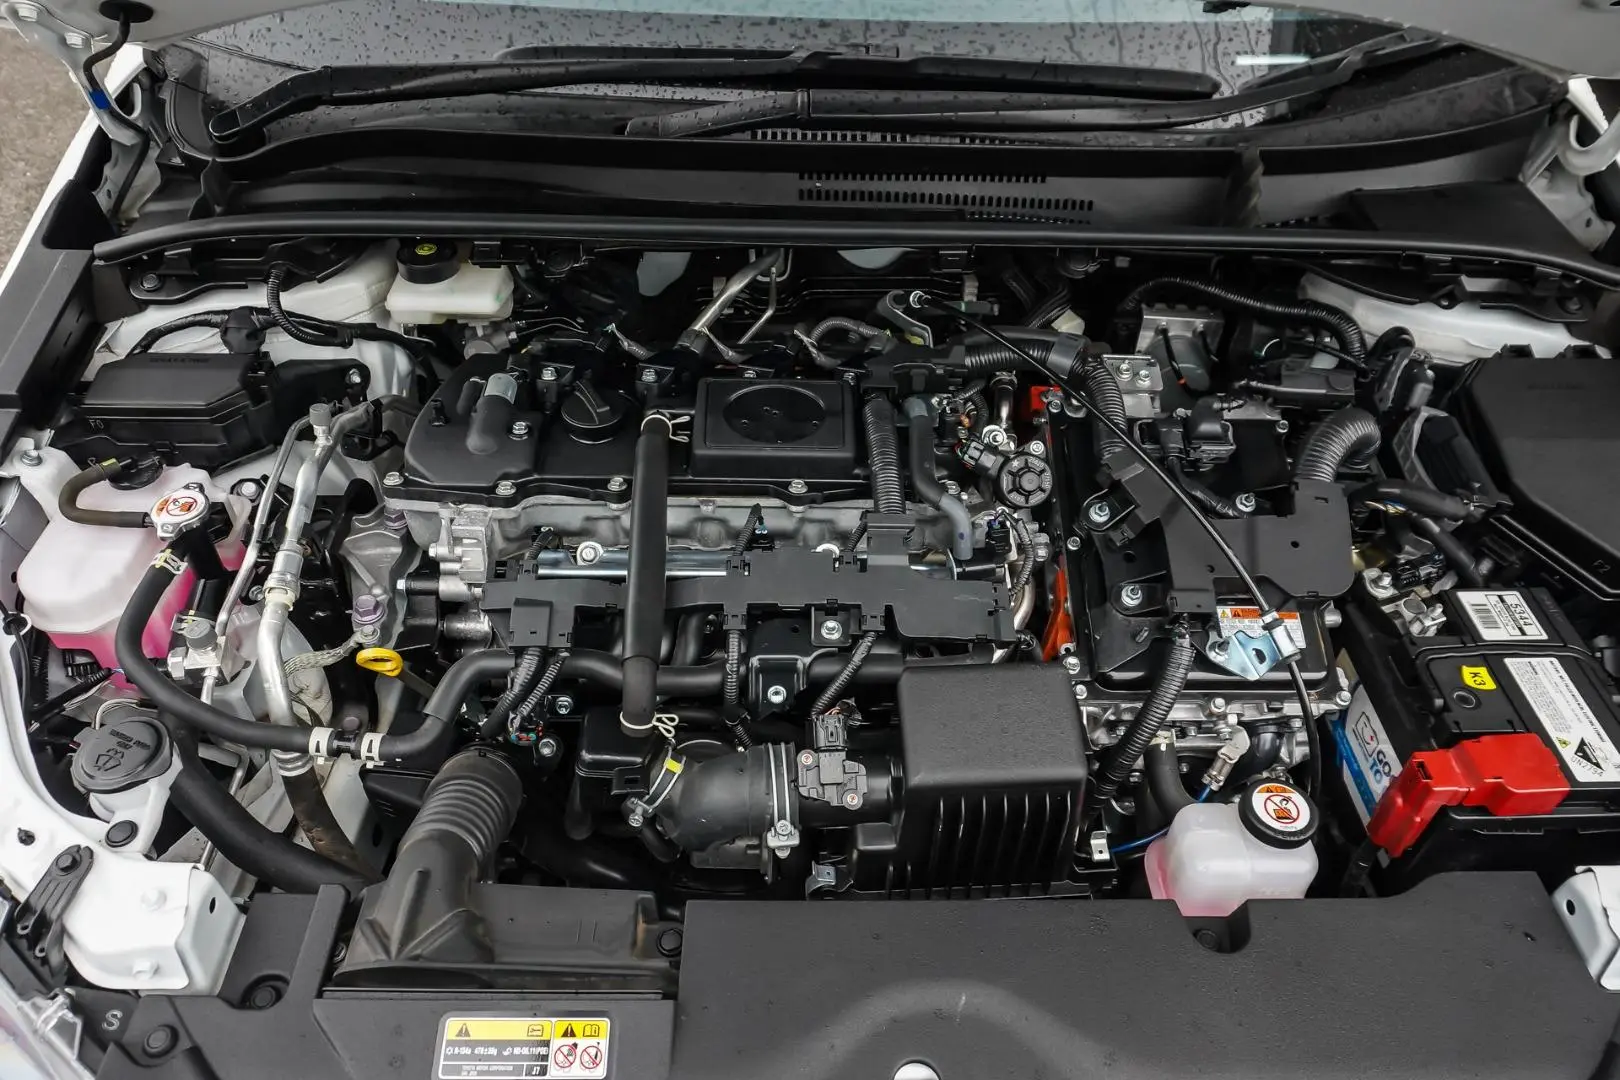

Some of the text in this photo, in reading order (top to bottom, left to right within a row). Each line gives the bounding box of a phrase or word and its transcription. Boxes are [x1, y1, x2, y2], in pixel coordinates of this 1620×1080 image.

[1510, 603, 1533, 626] 5344
[1469, 672, 1486, 686] K3
[101, 1009, 123, 1031] S
